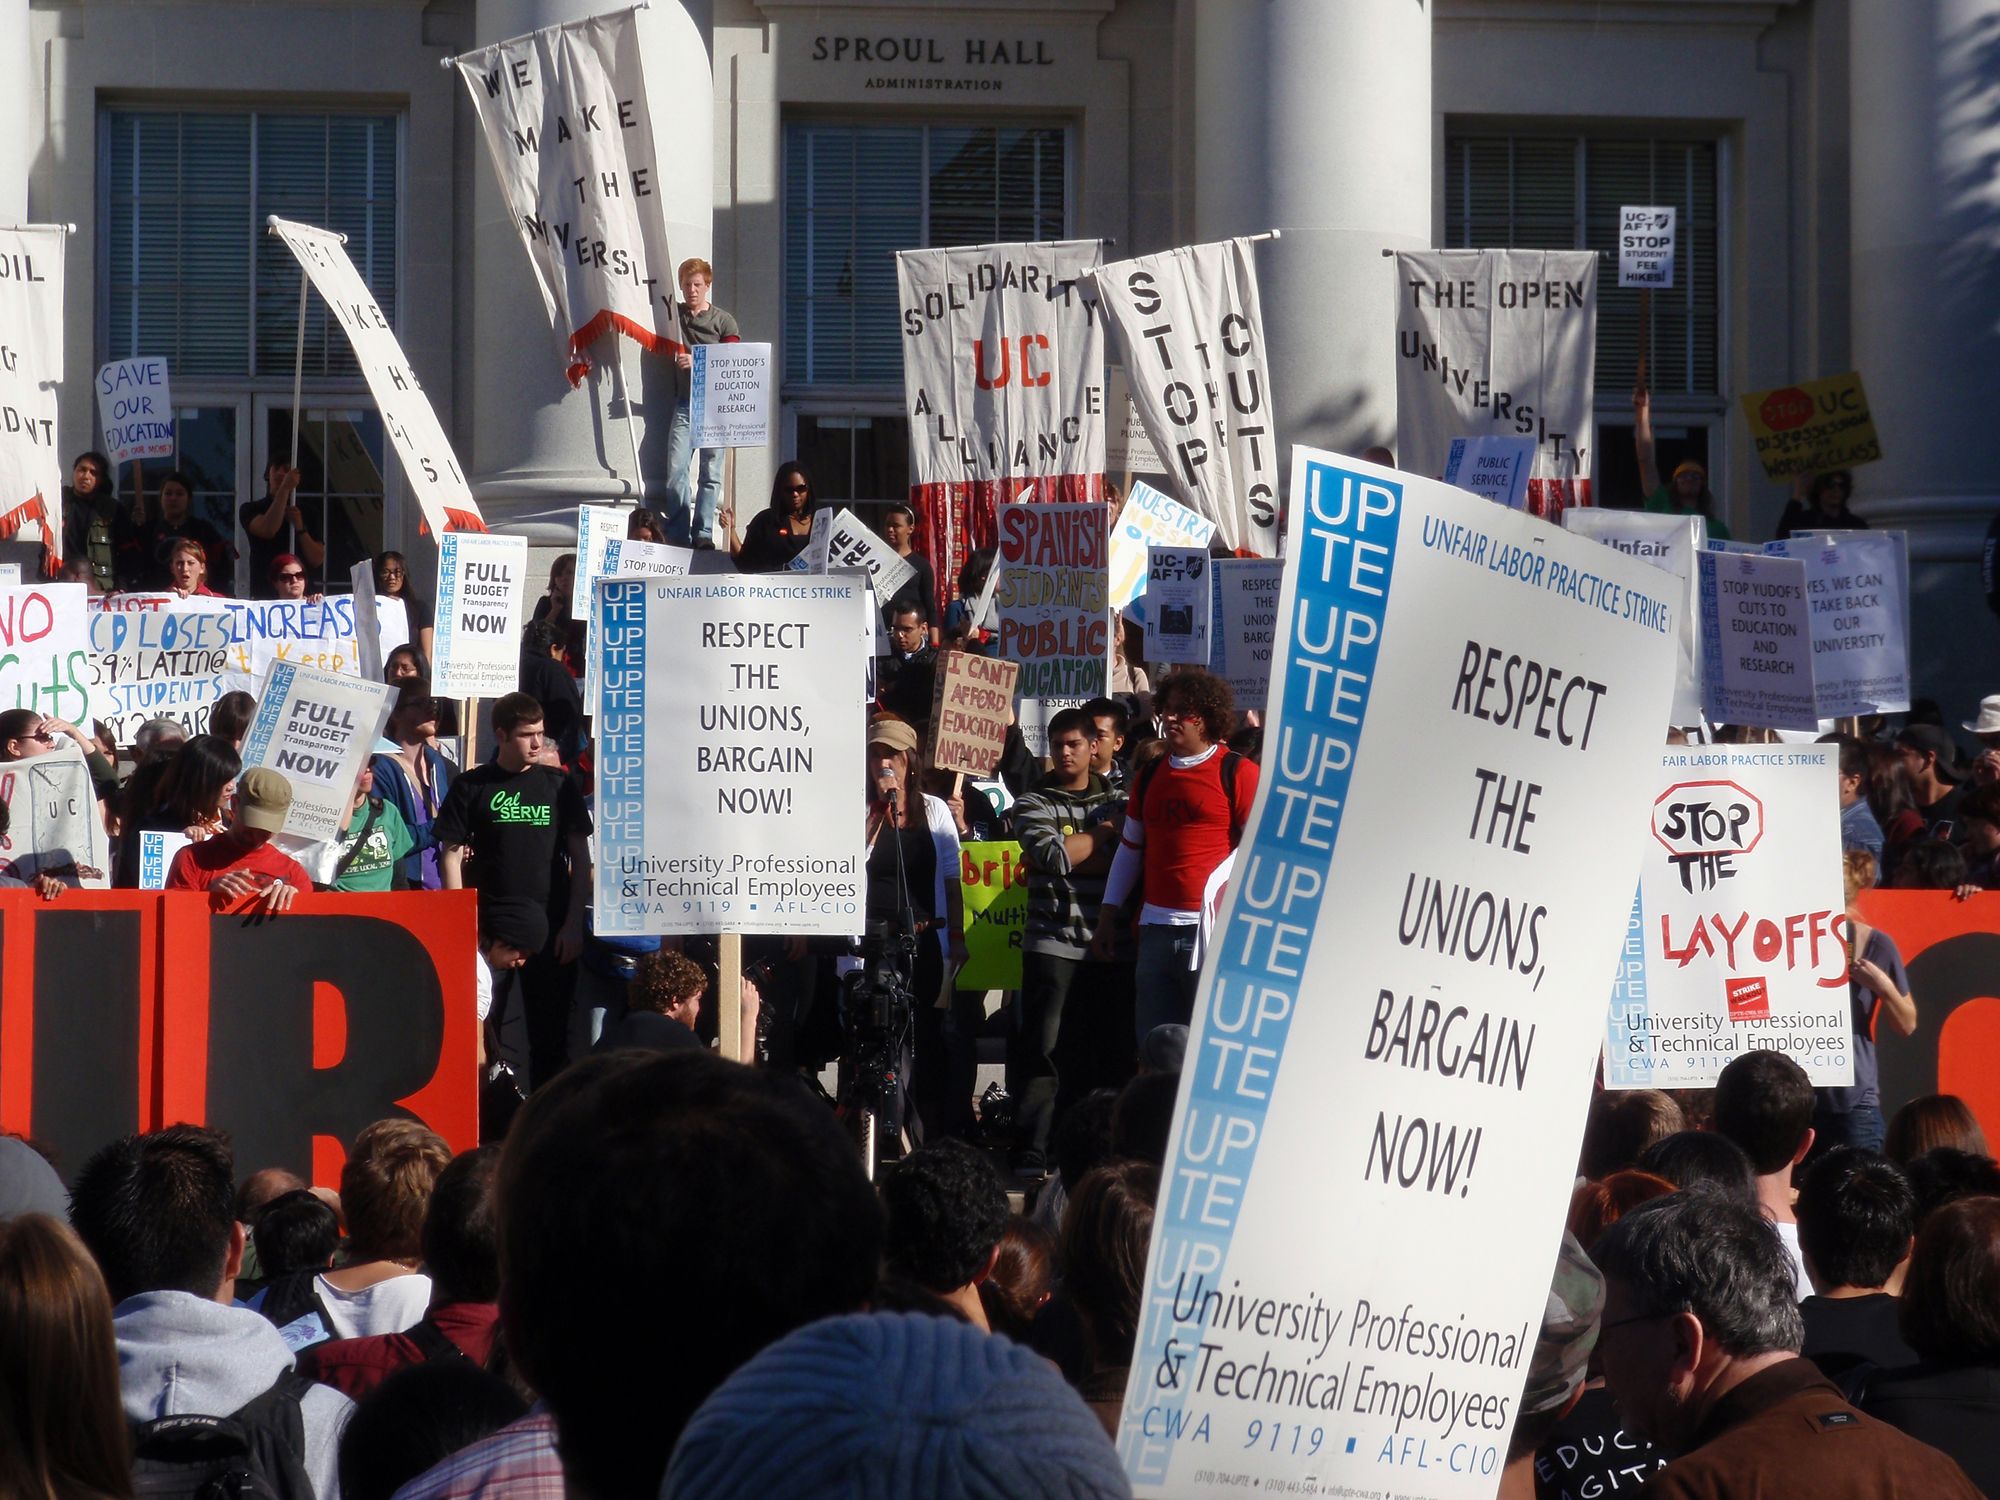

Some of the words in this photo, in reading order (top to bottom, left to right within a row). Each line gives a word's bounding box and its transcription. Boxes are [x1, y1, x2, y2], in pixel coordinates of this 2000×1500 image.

[812, 36, 945, 63] SPROUL
[965, 40, 1055, 65] HALL
[481, 60, 533, 98] WE
[865, 77, 1004, 91] ADMINISTRATION
[514, 100, 637, 156] MAKE
[573, 168, 651, 204] THE
[1623, 222, 1653, 231] AFT
[1623, 236, 1671, 248] STOP
[1624, 250, 1668, 258] STUDENT
[1626, 270, 1666, 282] HIKES!
[1636, 261, 1658, 270] FEE
[904, 261, 1097, 336] SOLIDARITY
[1409, 281, 1475, 309] THE
[1498, 280, 1583, 309] OPEN
[710, 359, 730, 368] STOP
[732, 358, 765, 367] YUDOF'S
[720, 370, 740, 379] CUTS
[743, 370, 754, 379] TO
[973, 334, 1051, 391] UC
[101, 363, 162, 395] SAVE
[714, 381, 760, 391] EDUCATION
[1128, 271, 1208, 487] STOP
[113, 396, 154, 420] OUR
[727, 393, 745, 401] AND
[1194, 342, 1228, 448] THE
[1401, 331, 1586, 475] UNIVERSITY
[1818, 387, 1859, 415] UC
[717, 404, 756, 414] RESEARCH
[1220, 312, 1275, 528] CUTS
[1764, 399, 1809, 421] STOP
[106, 420, 174, 452] EDUCATION
[914, 386, 1101, 470] ALLIANCE
[1477, 457, 1511, 469] PUBLIC
[1130, 482, 1210, 544] NUESTRA
[1311, 470, 1396, 532] UP
[464, 562, 511, 584] FULL
[623, 559, 646, 571] STOP
[648, 562, 684, 575] YUDOF'S
[1150, 568, 1185, 582] AFT
[1310, 527, 1389, 597] TE
[1422, 515, 1489, 566] UNFAIR
[1488, 539, 1545, 587] LABOR
[1547, 561, 1621, 615] PRACTICE
[1622, 589, 1668, 634] STRIKE
[463, 584, 510, 598] BUDGET
[657, 587, 702, 599] UNFAIR
[705, 586, 745, 599] LABOR
[749, 587, 807, 600] PRACTICE
[811, 586, 852, 600] STRIKE
[1000, 567, 1109, 614] STUDENTS
[1722, 579, 1749, 596] STOP
[1752, 583, 1800, 600] YUDOF'S
[1831, 578, 1852, 592] WE
[1855, 573, 1883, 589] CAN
[462, 597, 509, 610] Transparency
[1254, 596, 1274, 608] THE
[1738, 600, 1766, 616] CUTS
[1770, 603, 1786, 617] TO
[1812, 598, 1842, 614] TAKE
[1845, 594, 1879, 610] BACK
[138, 612, 233, 652] LOSES
[461, 613, 507, 635] NOW
[702, 622, 810, 649] RESPECT
[1297, 598, 1377, 661] UP
[1731, 619, 1798, 637] EDUCATION
[1833, 616, 1860, 631] OUR
[1752, 639, 1778, 655] AND
[1813, 632, 1886, 655] UNIVERSITY
[440, 660, 476, 673] University
[477, 660, 517, 671] Professional
[447, 670, 480, 681] Technical
[481, 671, 516, 683] Employees
[730, 663, 780, 690] THE
[948, 652, 965, 675] I
[967, 657, 1017, 690] CAN'T
[1739, 656, 1795, 675] RESEARCH
[108, 674, 224, 716] STUDENTS
[319, 674, 339, 687] LABOR
[337, 680, 363, 692] PRACTICE
[1295, 657, 1367, 725] TE
[1451, 639, 1608, 751] RESPECT
[1758, 688, 1814, 703] Professional
[950, 682, 1007, 713] AFFORD
[291, 699, 355, 731] FULL
[700, 705, 810, 737] UNIONS,
[942, 709, 1009, 745] EDUCATION
[283, 734, 346, 756] Transparency
[287, 720, 351, 744] BUDGET
[275, 749, 340, 780] NOW
[697, 746, 813, 773] BARGAIN
[936, 738, 1000, 772] ANYMORE
[1280, 726, 1351, 787] UP
[1690, 754, 1729, 767] LABOR
[1731, 754, 1784, 766] PRACTICE
[1787, 754, 1826, 766] STRIKE
[490, 790, 520, 813] Cal
[500, 805, 551, 820] SERVE
[718, 787, 792, 815] NOW!
[1469, 767, 1543, 855] THE
[290, 807, 338, 827] Employees
[1276, 785, 1340, 850] TE
[1661, 801, 1751, 848] STOP
[621, 854, 724, 878] University
[732, 854, 856, 874] Professional
[1667, 850, 1738, 894] THE
[621, 879, 639, 898] &
[643, 877, 739, 897] Technical
[748, 877, 857, 902] Employees
[1244, 855, 1322, 915] UP
[621, 902, 665, 915] CWA
[682, 900, 732, 913] 9119
[773, 902, 857, 915] AFL-CIO
[1238, 913, 1308, 978] TE
[1398, 871, 1548, 993] UNIONS,
[1660, 909, 1851, 989] LAYOFFS
[1732, 982, 1762, 997] STRIKE
[1212, 978, 1290, 1038] UP
[1626, 1012, 1724, 1035] University
[1364, 988, 1537, 1092] BARGAIN
[1628, 1036, 1645, 1053] &
[1648, 1033, 1739, 1053] Technical
[1747, 1033, 1845, 1053] Employees
[1208, 1037, 1277, 1100] TE
[1628, 1058, 1670, 1070] CWA
[1687, 1055, 1732, 1068] 9119
[1364, 1110, 1483, 1199] NOW!
[1172, 1271, 1343, 1360] University
[1348, 1299, 1529, 1370] Professional
[1156, 1338, 1187, 1390] &
[1195, 1343, 1351, 1412] Technical
[1353, 1365, 1510, 1440] Employees
[1142, 1406, 1210, 1444] CWA
[1243, 1419, 1324, 1457] 9119
[1376, 1434, 1497, 1476] AFL-CIO
